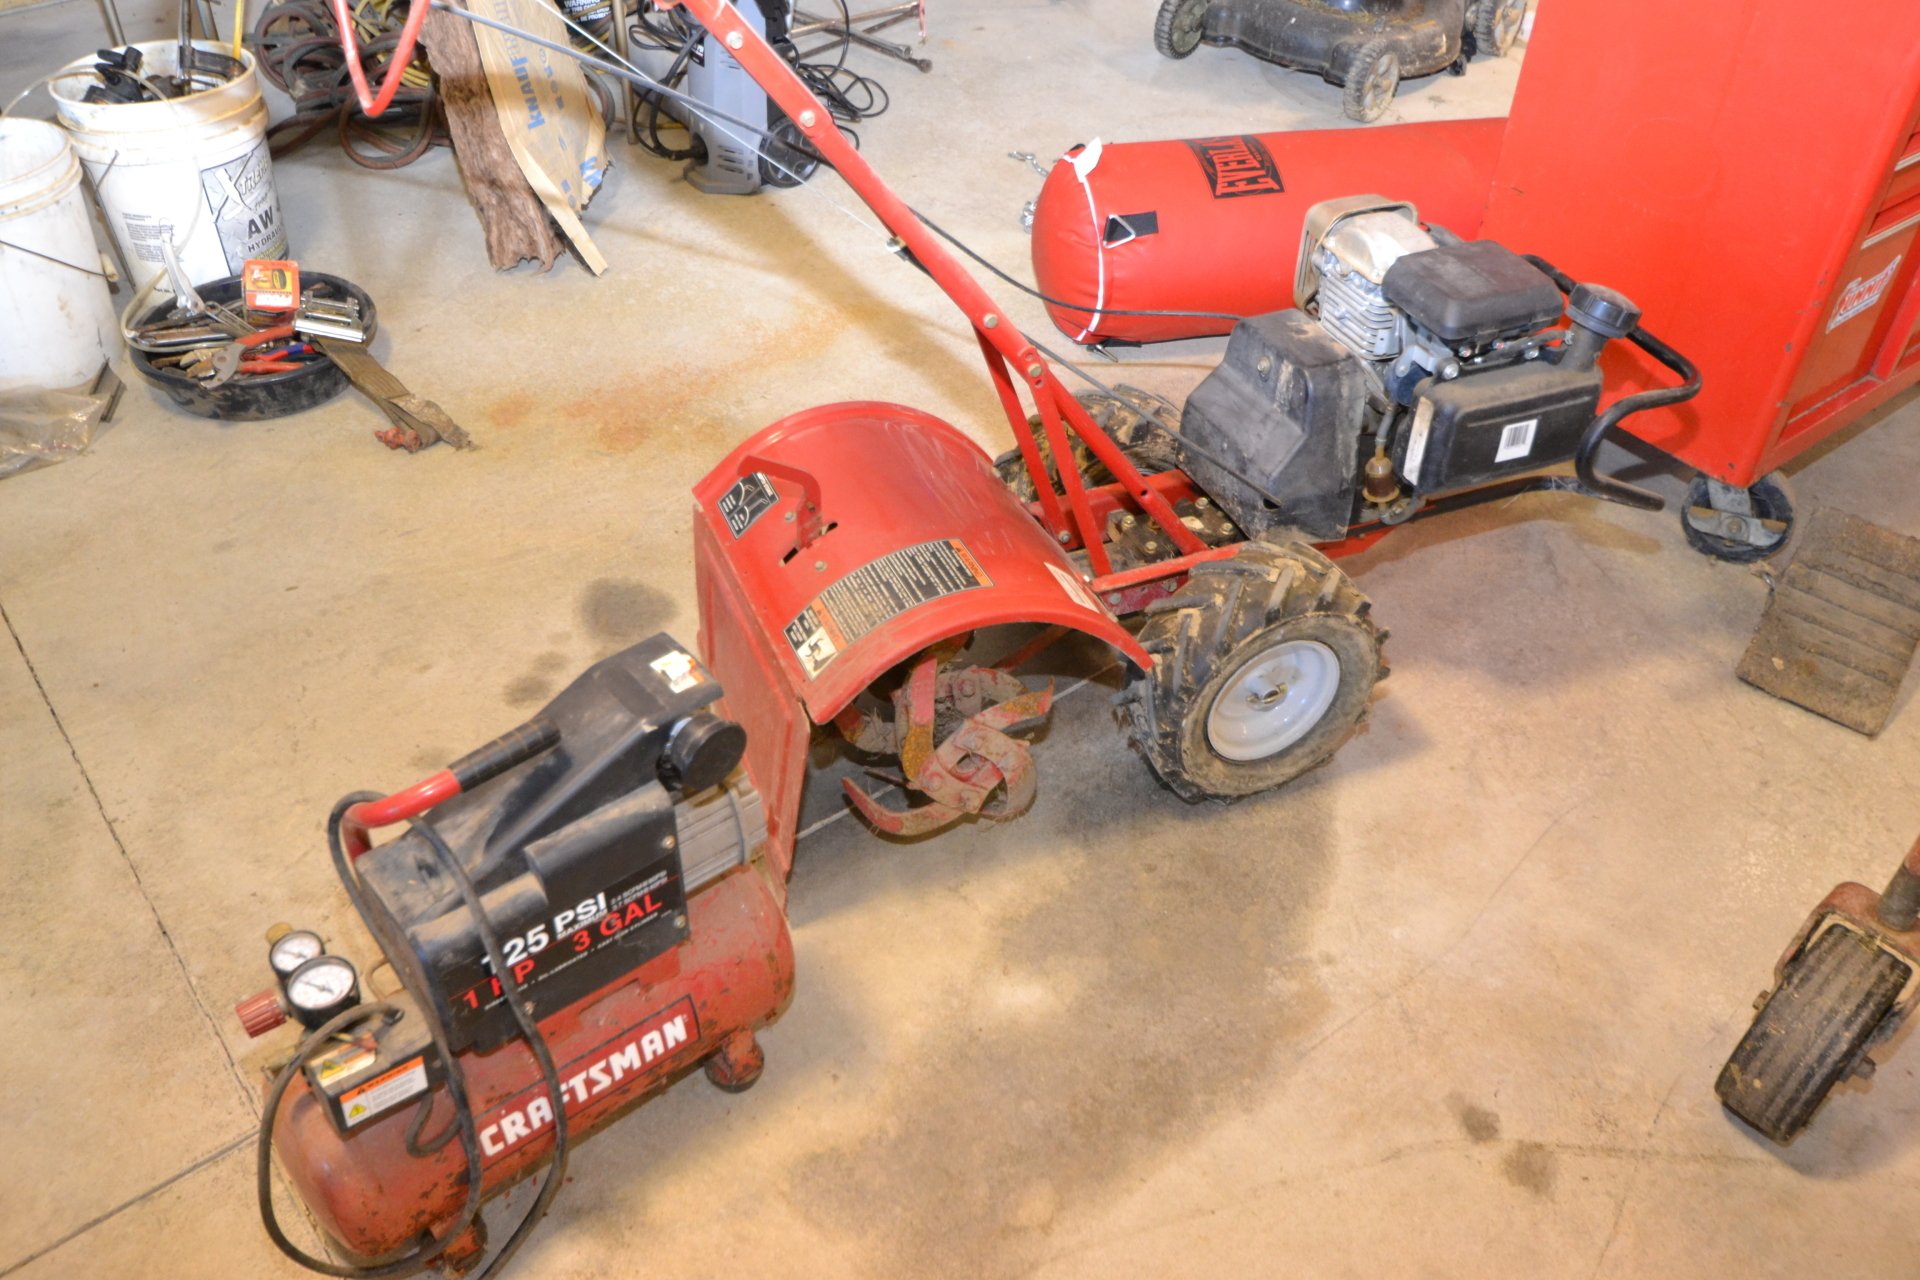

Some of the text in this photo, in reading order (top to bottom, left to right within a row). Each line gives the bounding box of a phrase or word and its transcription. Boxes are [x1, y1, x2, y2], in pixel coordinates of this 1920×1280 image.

[247, 205, 274, 240] AW
[553, 891, 608, 934] PSI
[463, 989, 479, 1010] 1
[572, 929, 592, 953] 3
[599, 893, 664, 937] GAL
